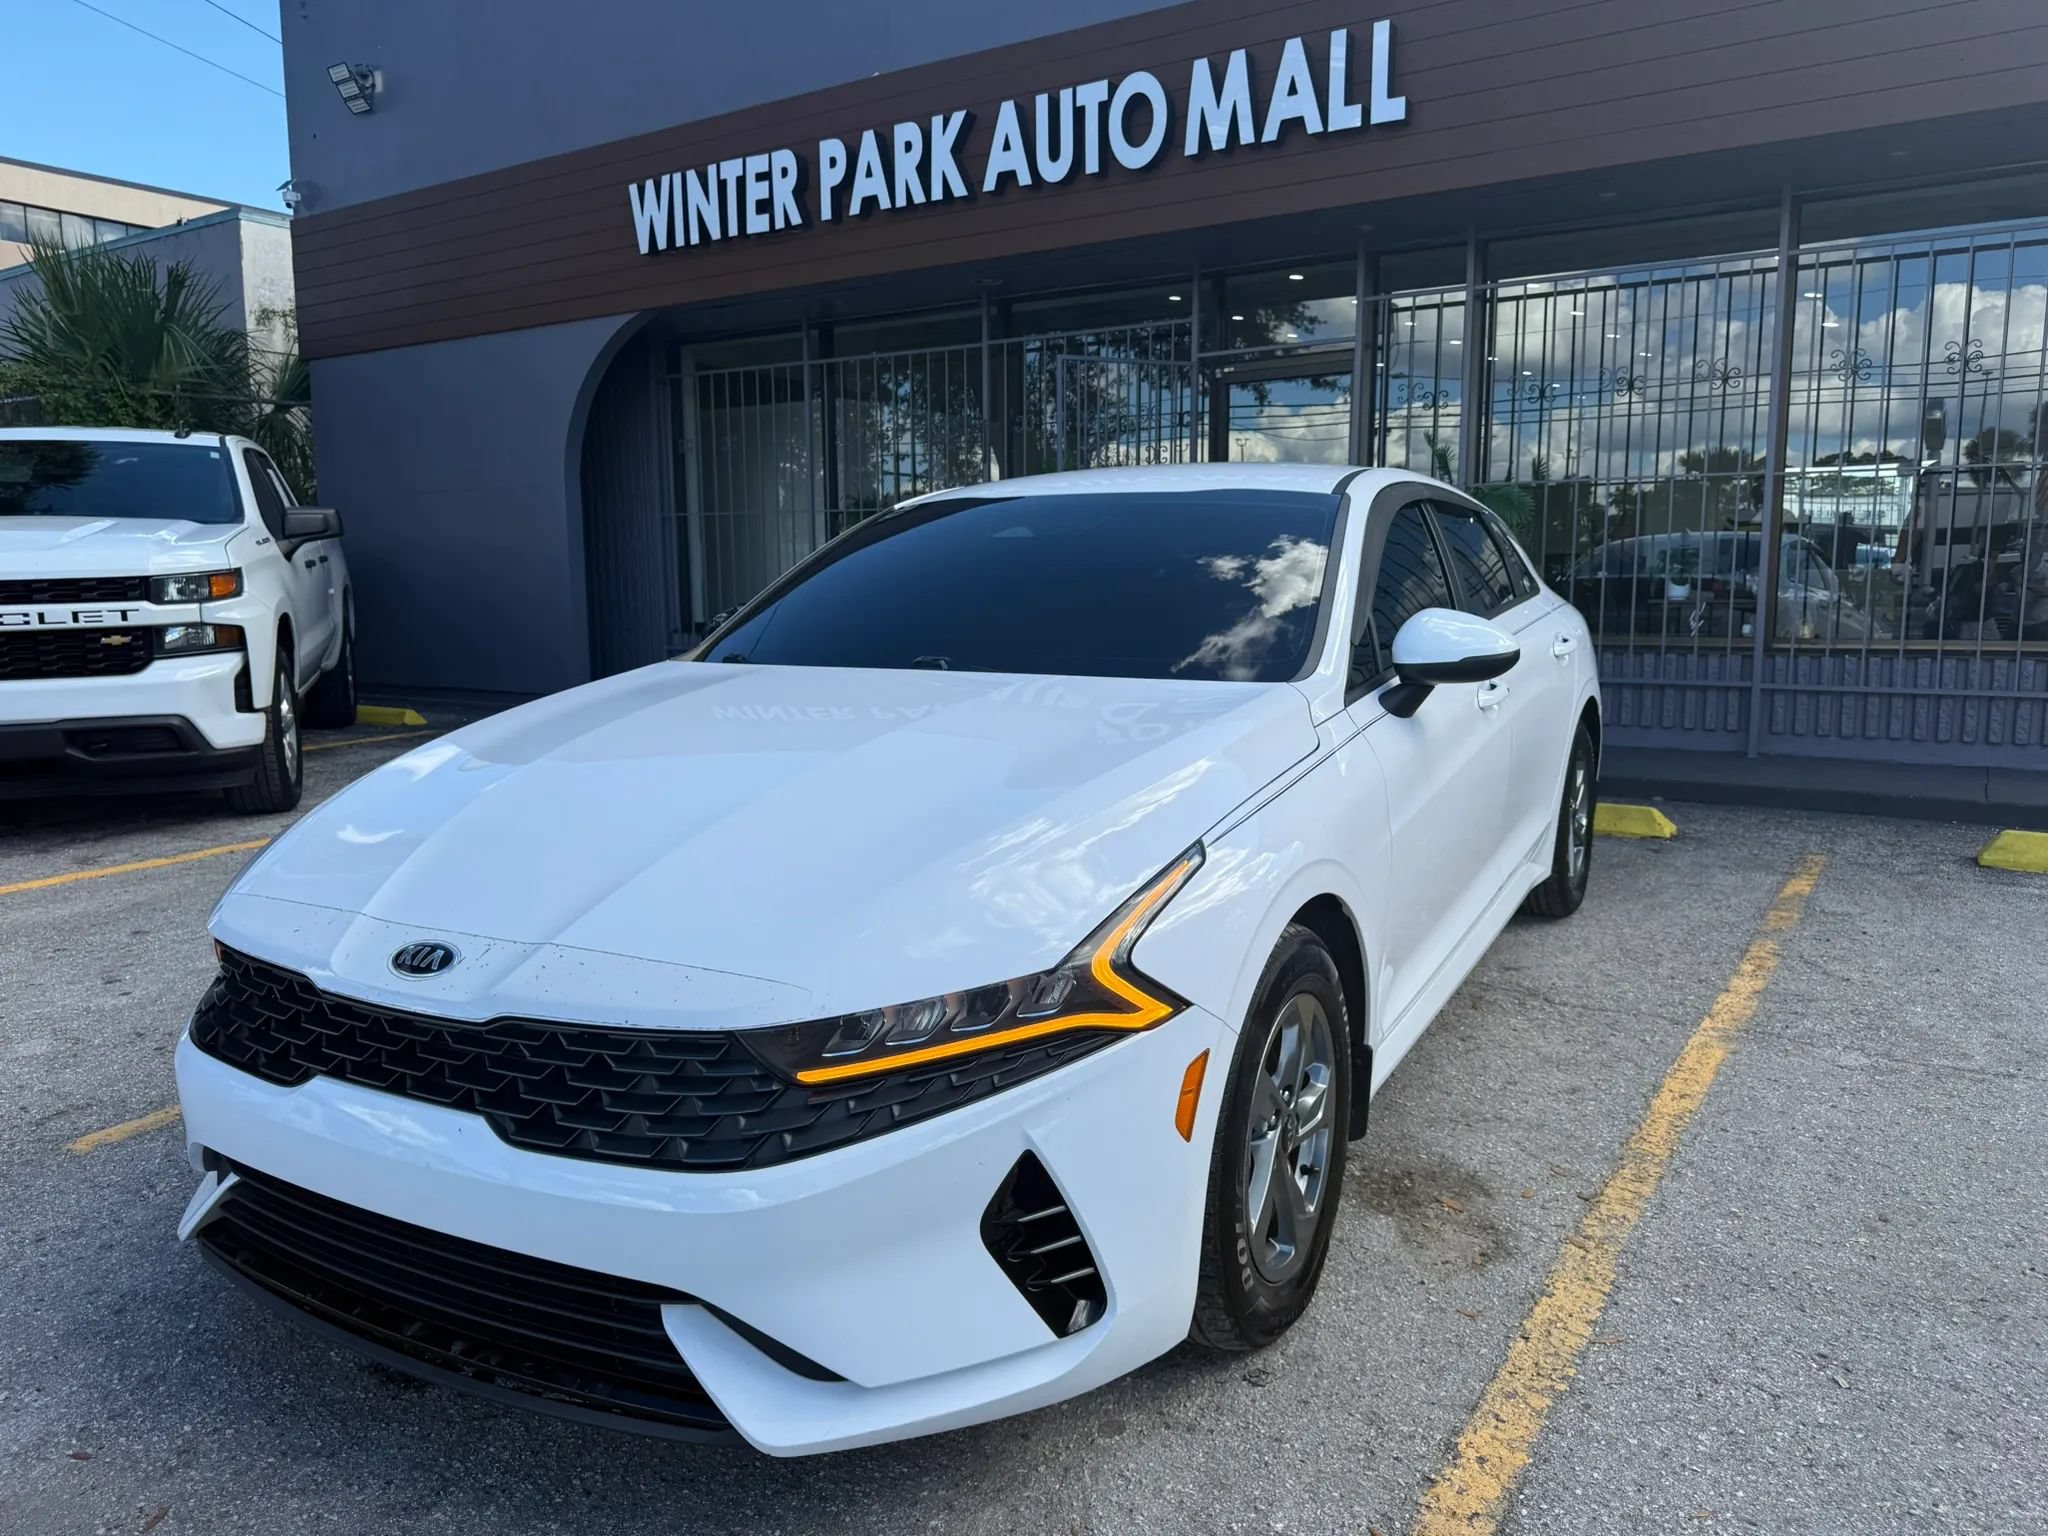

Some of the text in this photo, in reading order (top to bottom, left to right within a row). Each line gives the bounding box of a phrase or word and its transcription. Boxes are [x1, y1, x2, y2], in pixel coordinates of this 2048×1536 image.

[628, 19, 1407, 255] WINTER PARK AUTO MALL
[397, 945, 446, 971] KIA
